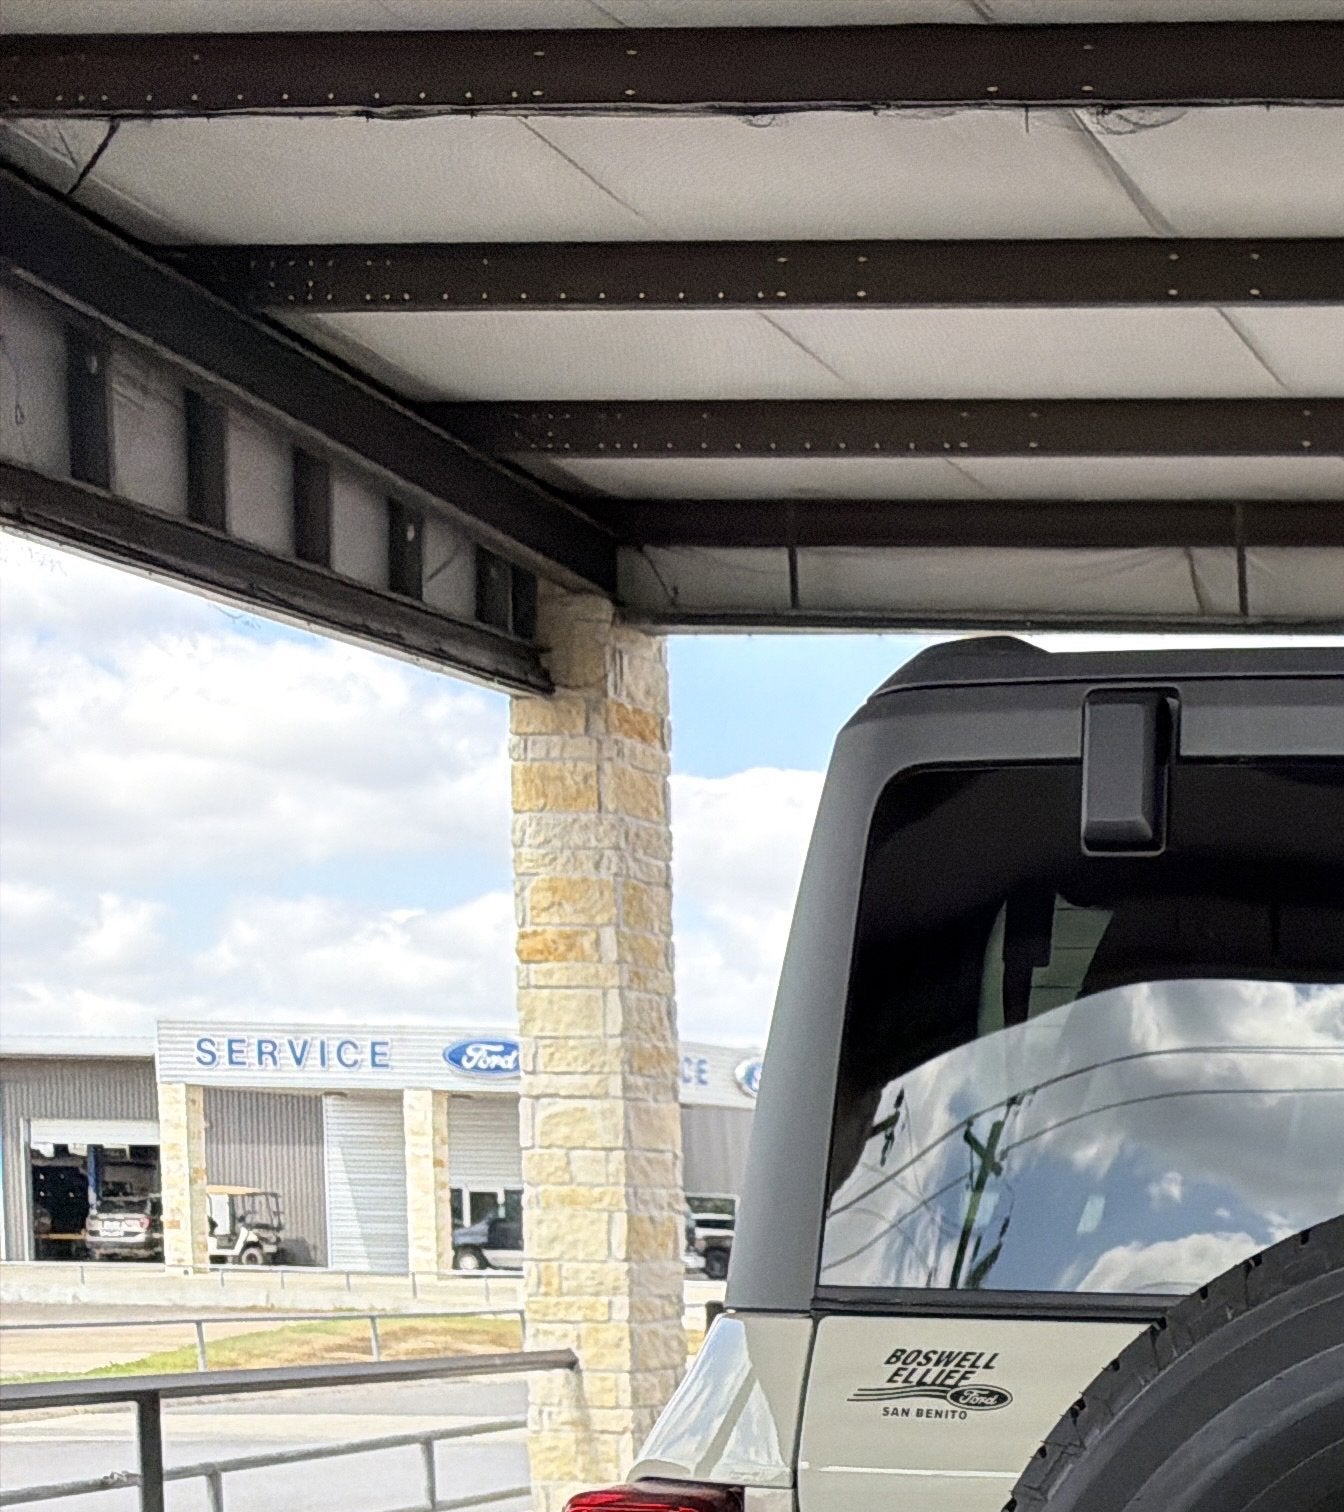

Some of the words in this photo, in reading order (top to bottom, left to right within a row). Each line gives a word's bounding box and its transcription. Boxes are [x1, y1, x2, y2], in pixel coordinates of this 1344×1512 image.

[195, 1037, 391, 1069] SERVICE
[883, 1348, 1000, 1370] BOSWELL
[885, 1366, 977, 1387] ELLIFF
[959, 1389, 1000, 1406] Ford
[881, 1406, 910, 1419] SAN
[915, 1407, 968, 1421] BENITO
